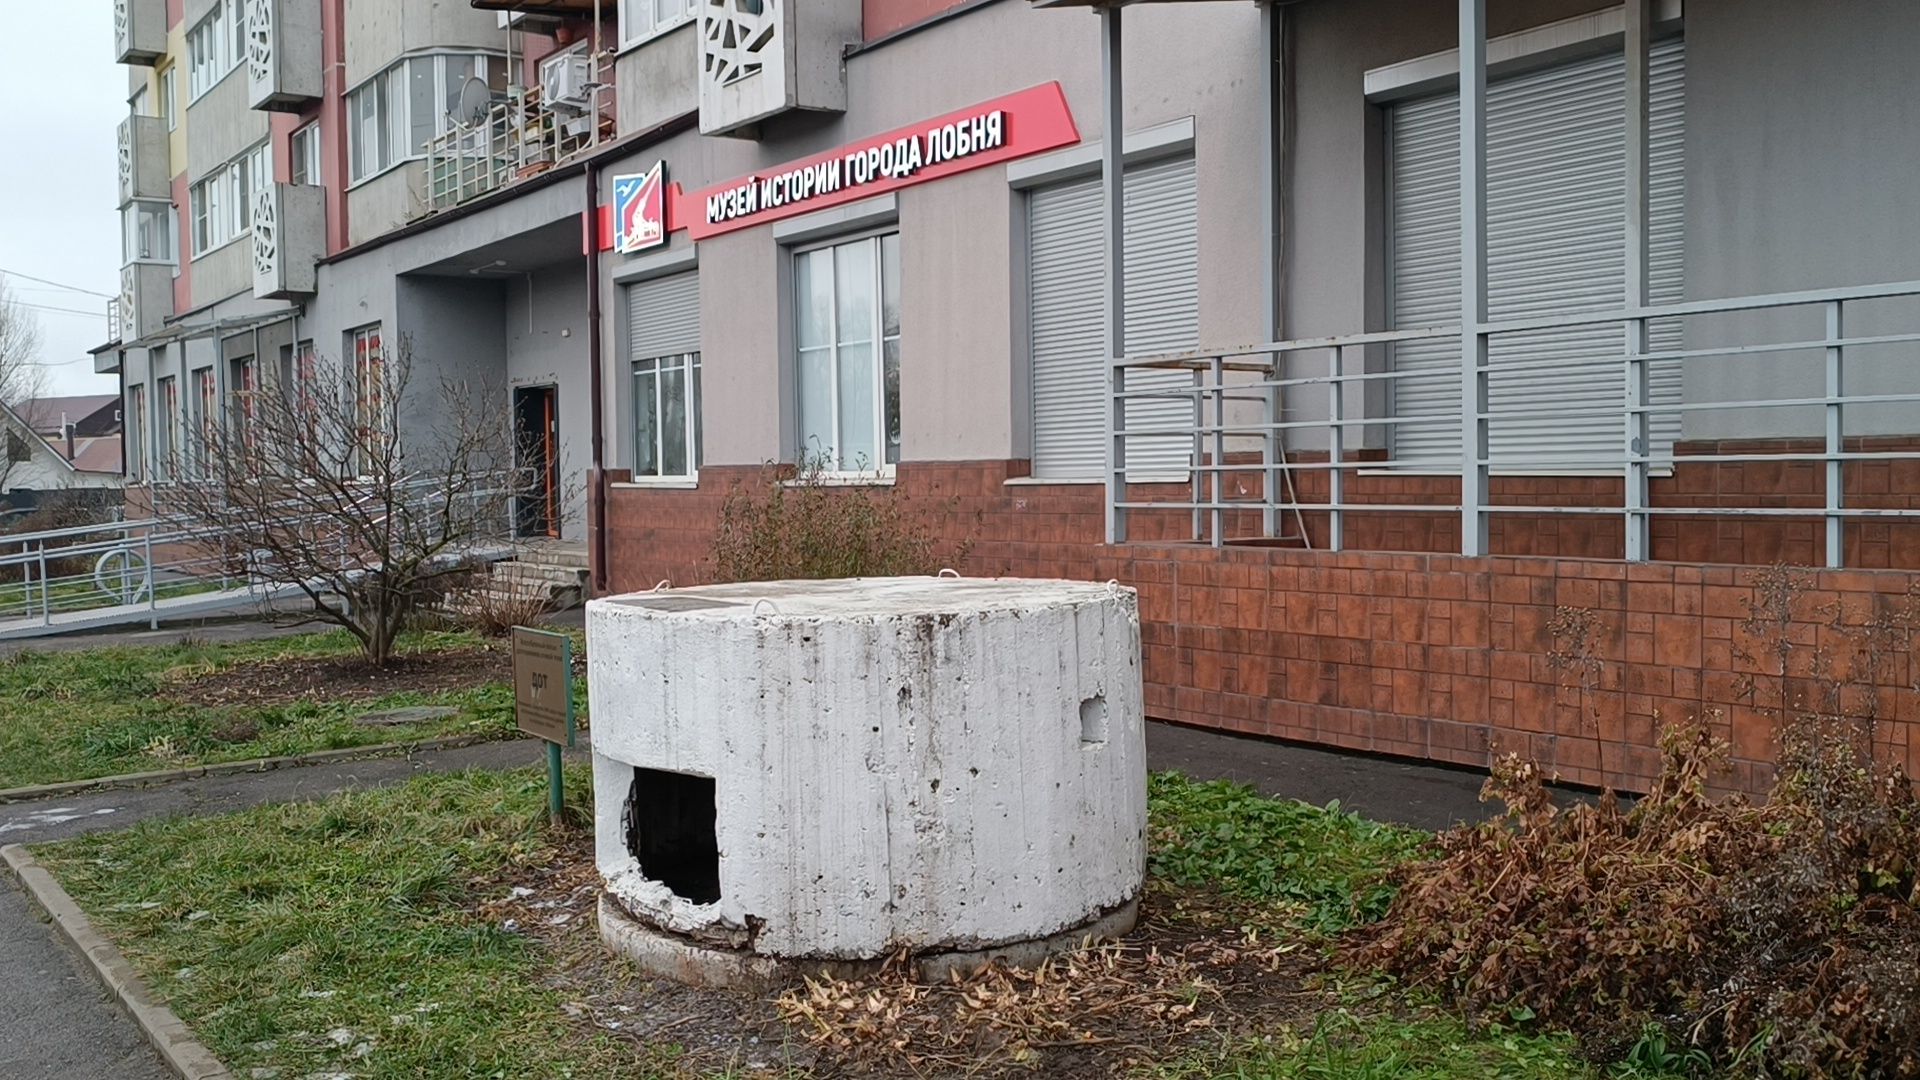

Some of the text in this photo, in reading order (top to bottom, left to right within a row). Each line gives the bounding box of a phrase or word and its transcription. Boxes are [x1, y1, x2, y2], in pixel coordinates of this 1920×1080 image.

[706, 110, 1002, 224] МУЗЕЙ ИСТОРИИ ГОРОДА ЛОБНЯ
